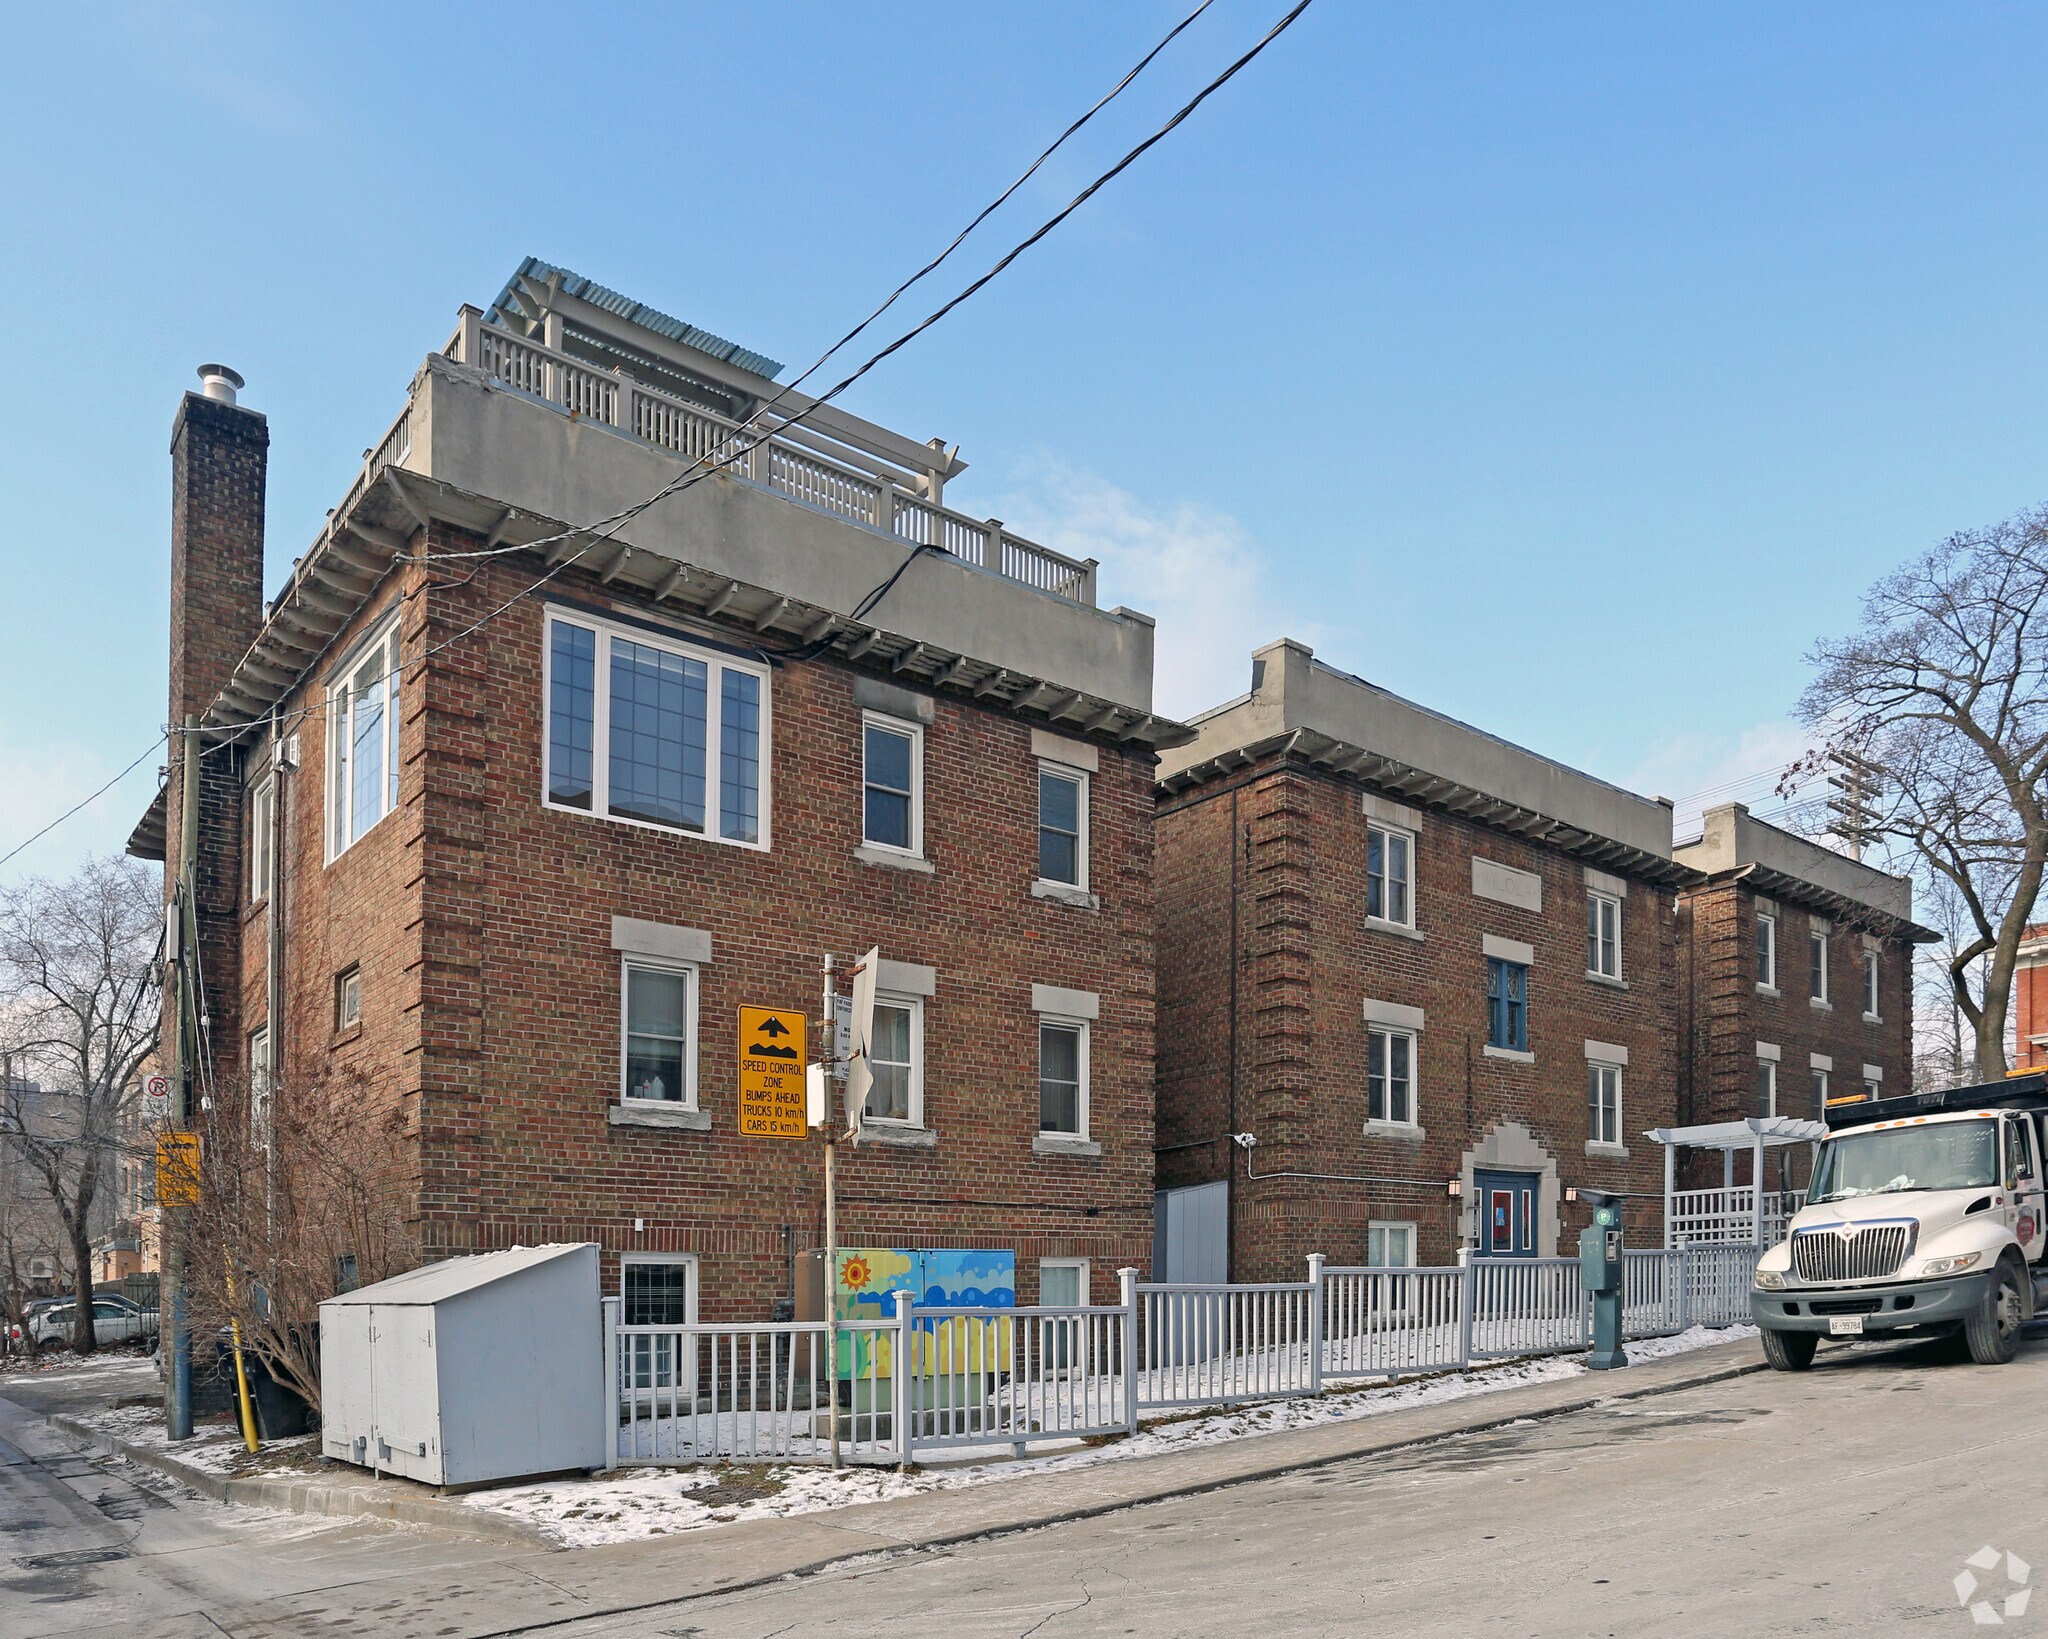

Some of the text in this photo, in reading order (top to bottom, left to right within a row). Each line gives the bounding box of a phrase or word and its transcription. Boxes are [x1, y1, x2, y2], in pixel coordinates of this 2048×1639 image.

[742, 1060, 803, 1076] SPEED CONTROL
[763, 1076, 783, 1088] ZONE
[746, 1089, 800, 1104] BUMPS AHEAD
[742, 1104, 805, 1119] TRUCKS 10 km/h
[747, 1119, 800, 1133] CARS 15 km/h
